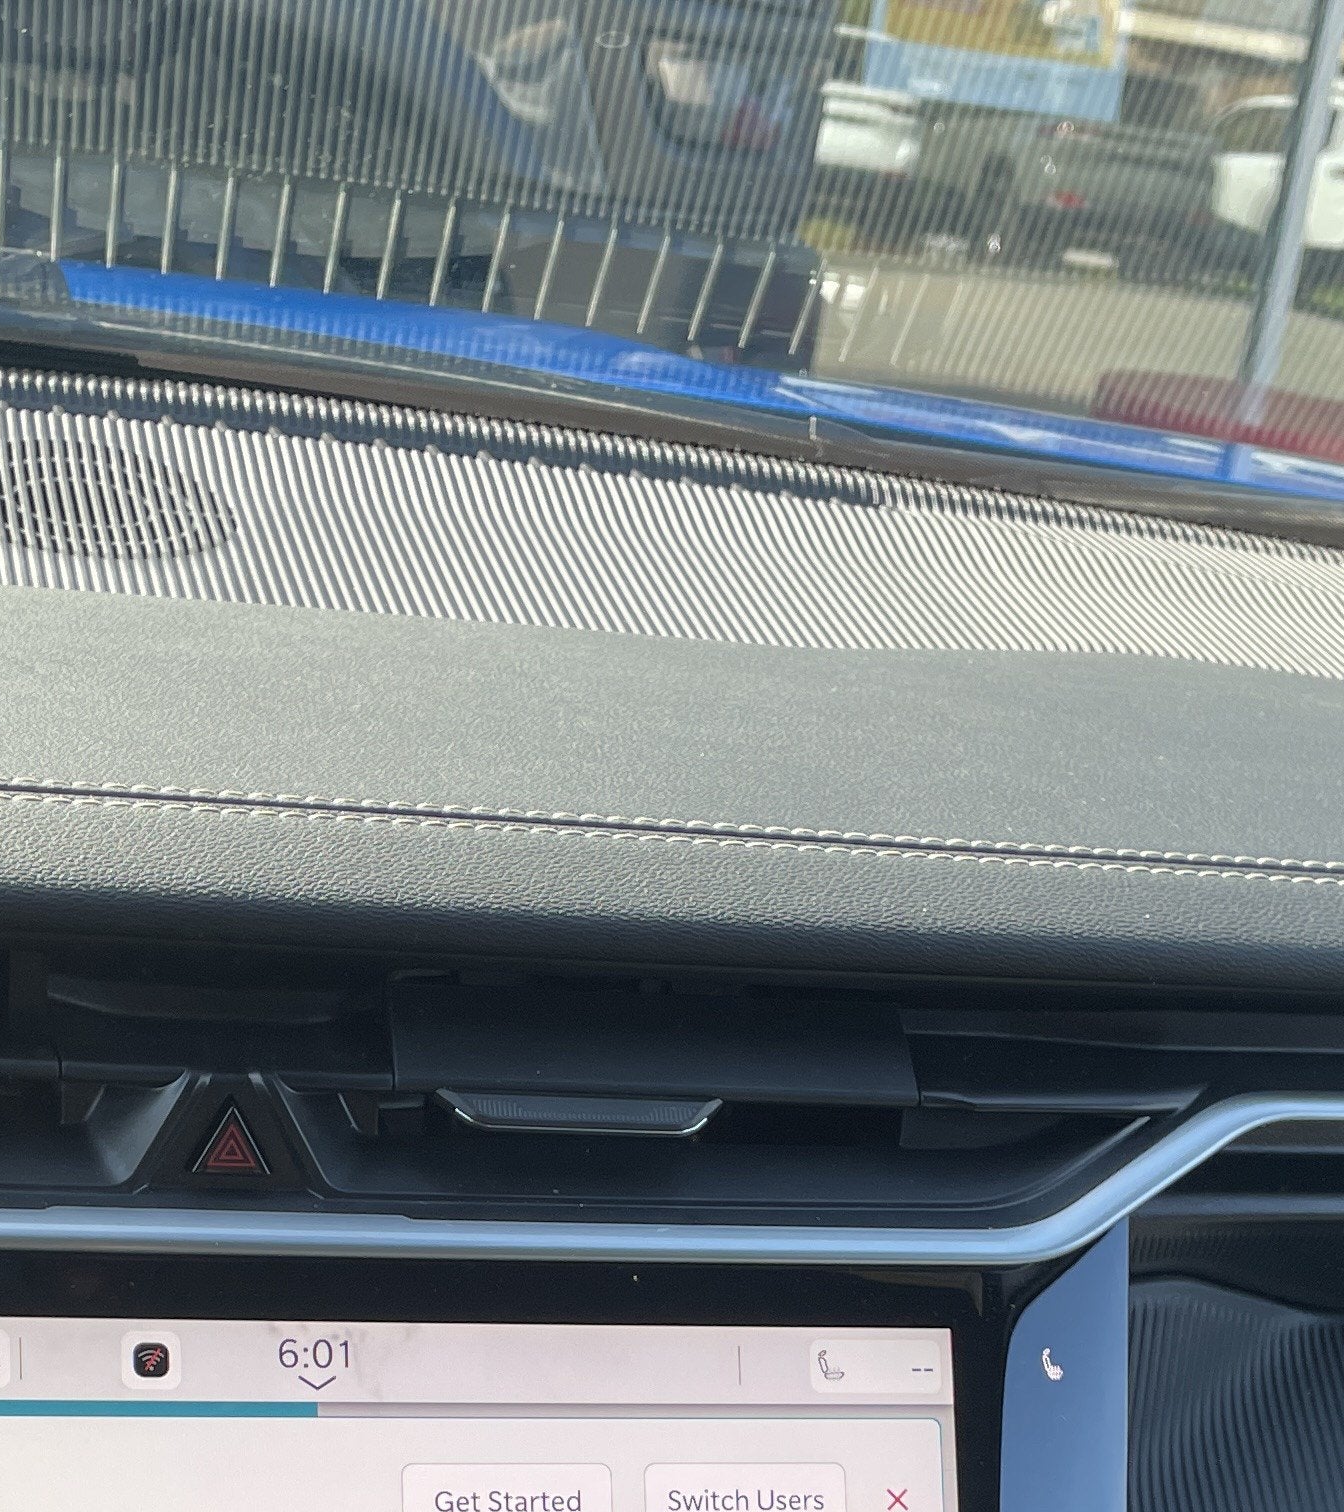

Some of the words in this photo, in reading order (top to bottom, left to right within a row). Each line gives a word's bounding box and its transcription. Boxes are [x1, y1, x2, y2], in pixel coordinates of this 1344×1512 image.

[276, 1338, 353, 1370] 6:01
[667, 1489, 751, 1512] Switch
[757, 1489, 825, 1512] Users
